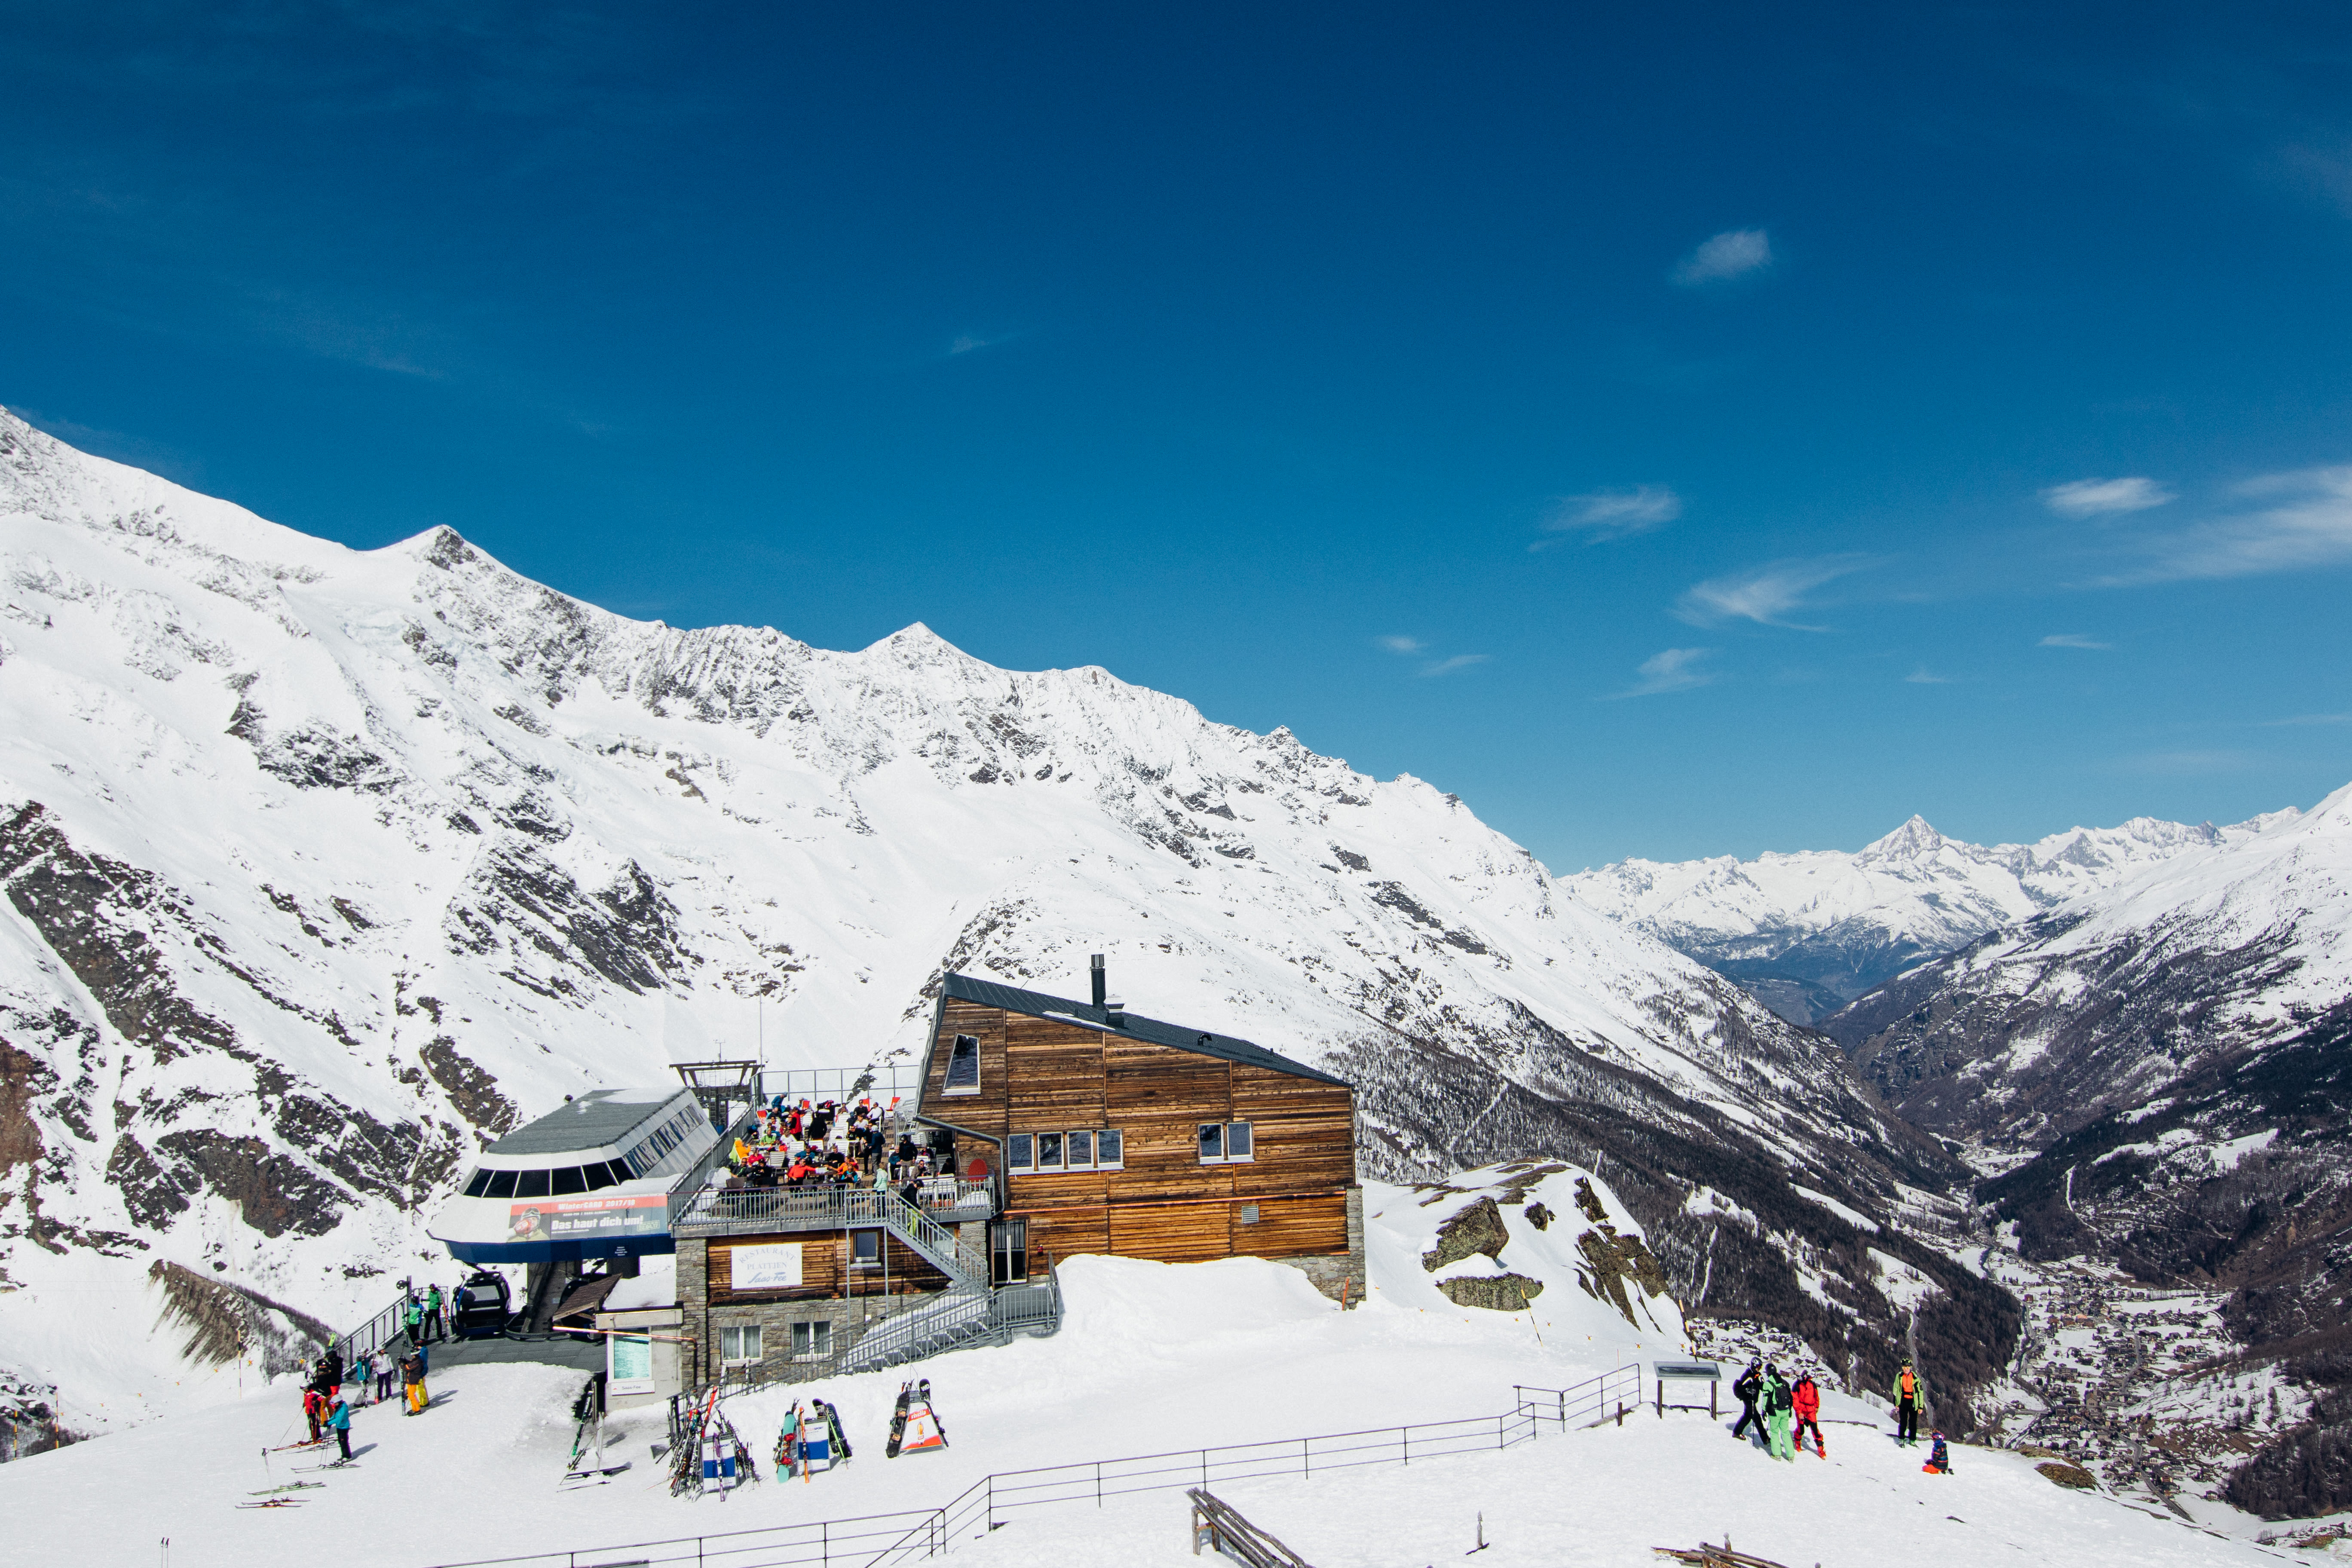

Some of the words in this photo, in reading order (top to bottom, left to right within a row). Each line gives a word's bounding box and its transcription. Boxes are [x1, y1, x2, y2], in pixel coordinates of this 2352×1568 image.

[558, 1201, 603, 1210] WinterCARD
[551, 1220, 572, 1230] Das
[573, 1219, 597, 1228] haut
[600, 1216, 622, 1227] dich
[624, 1215, 643, 1225] um!
[739, 1247, 796, 1263] RESTAURANT
[911, 1409, 926, 1419] rivella
